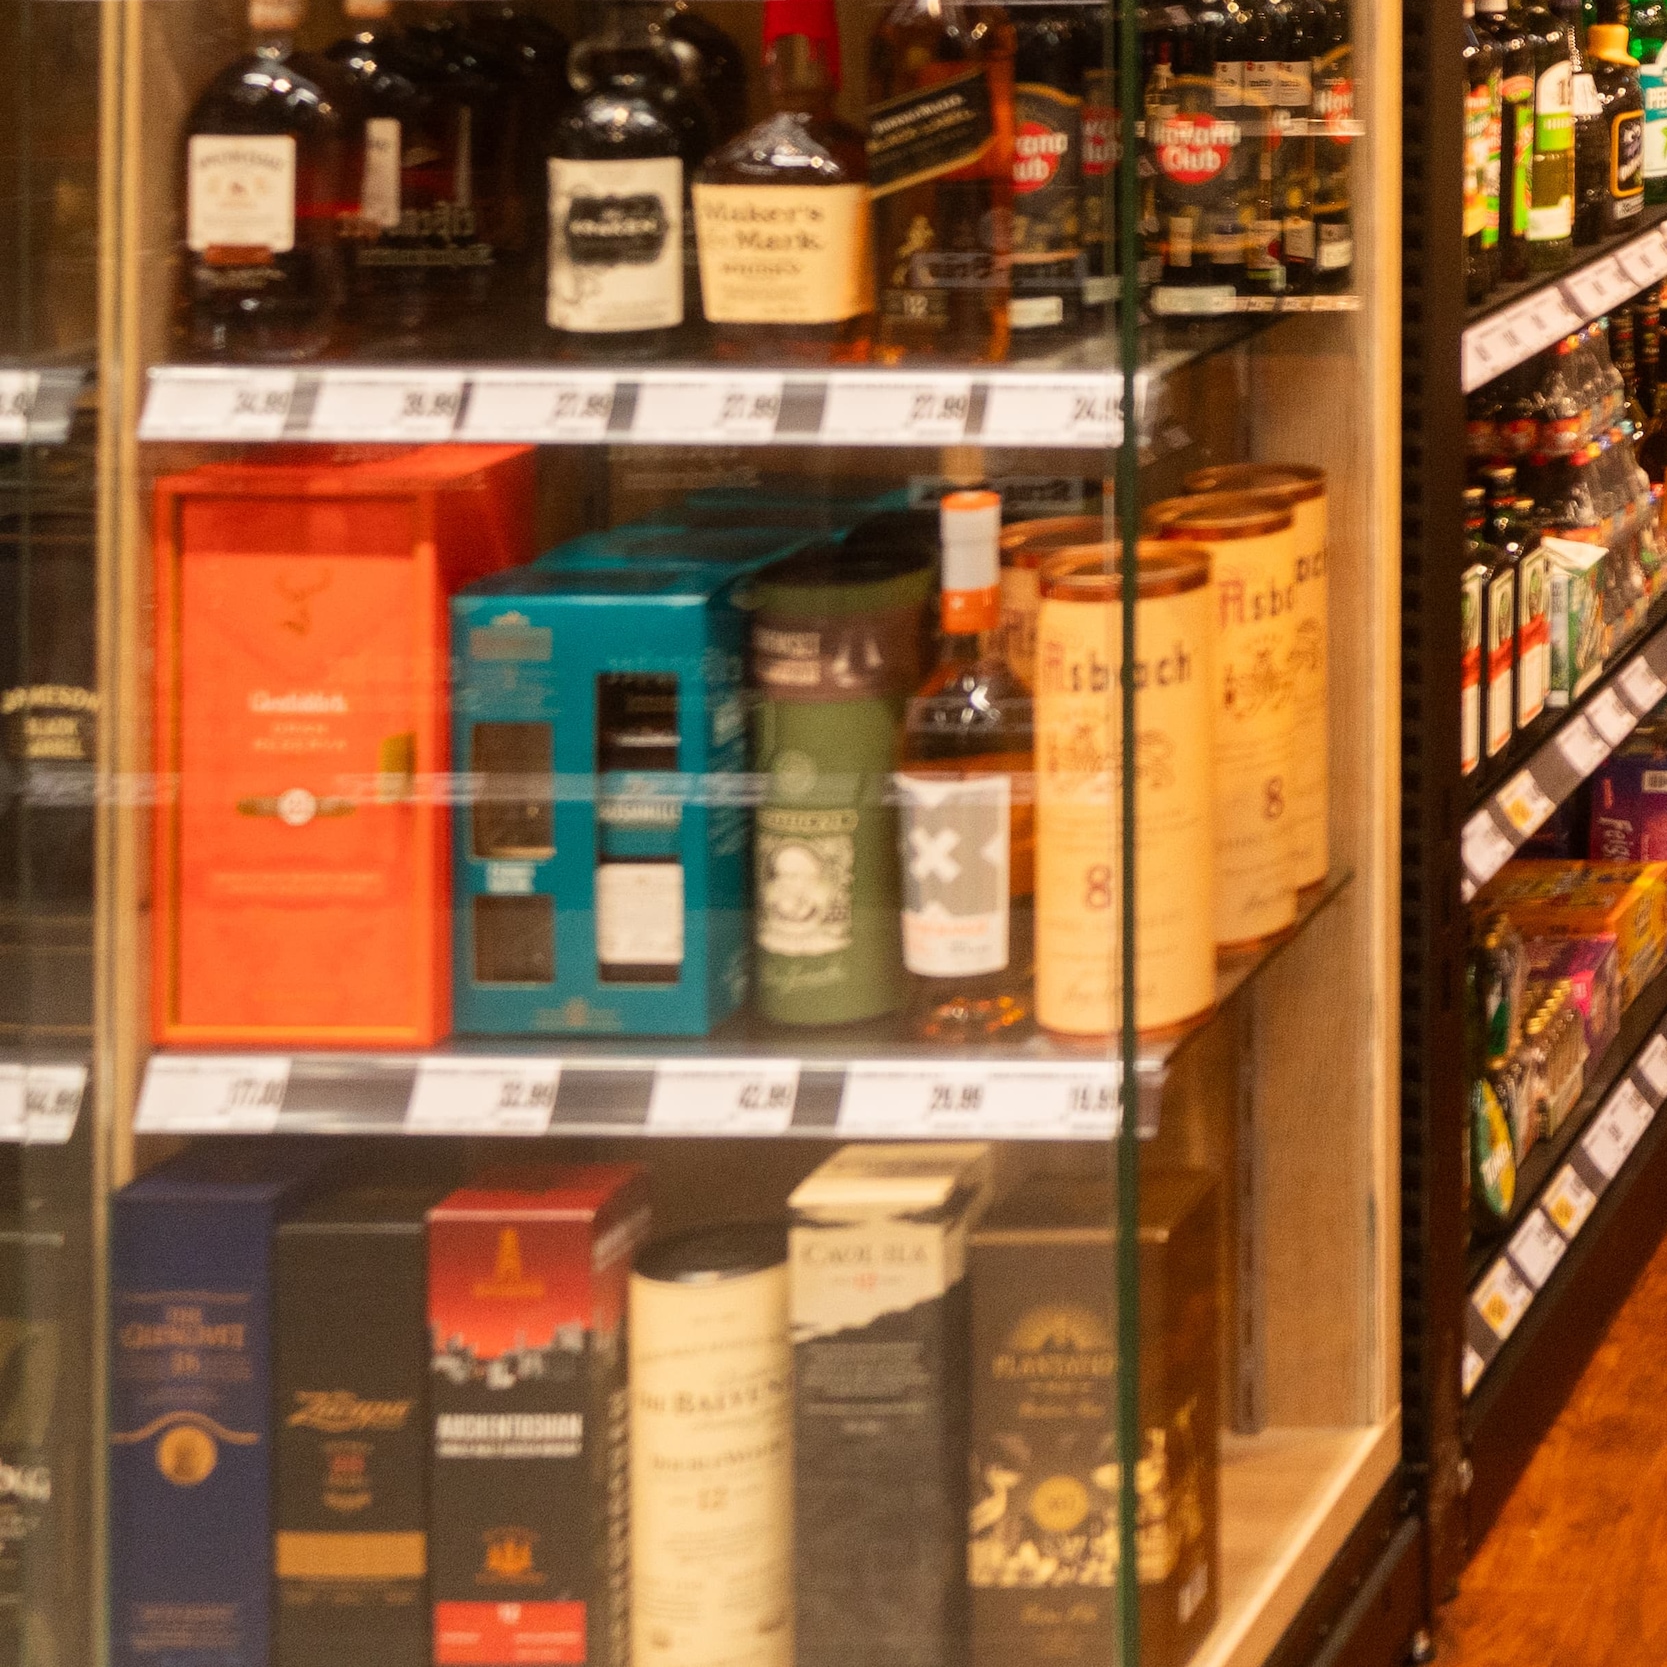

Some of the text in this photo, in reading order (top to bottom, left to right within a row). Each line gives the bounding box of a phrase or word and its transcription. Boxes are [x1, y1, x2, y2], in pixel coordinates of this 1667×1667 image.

[1164, 147, 1223, 176] Club
[703, 202, 814, 229] Maker's
[1261, 777, 1284, 820] 8
[1086, 864, 1114, 910] 8
